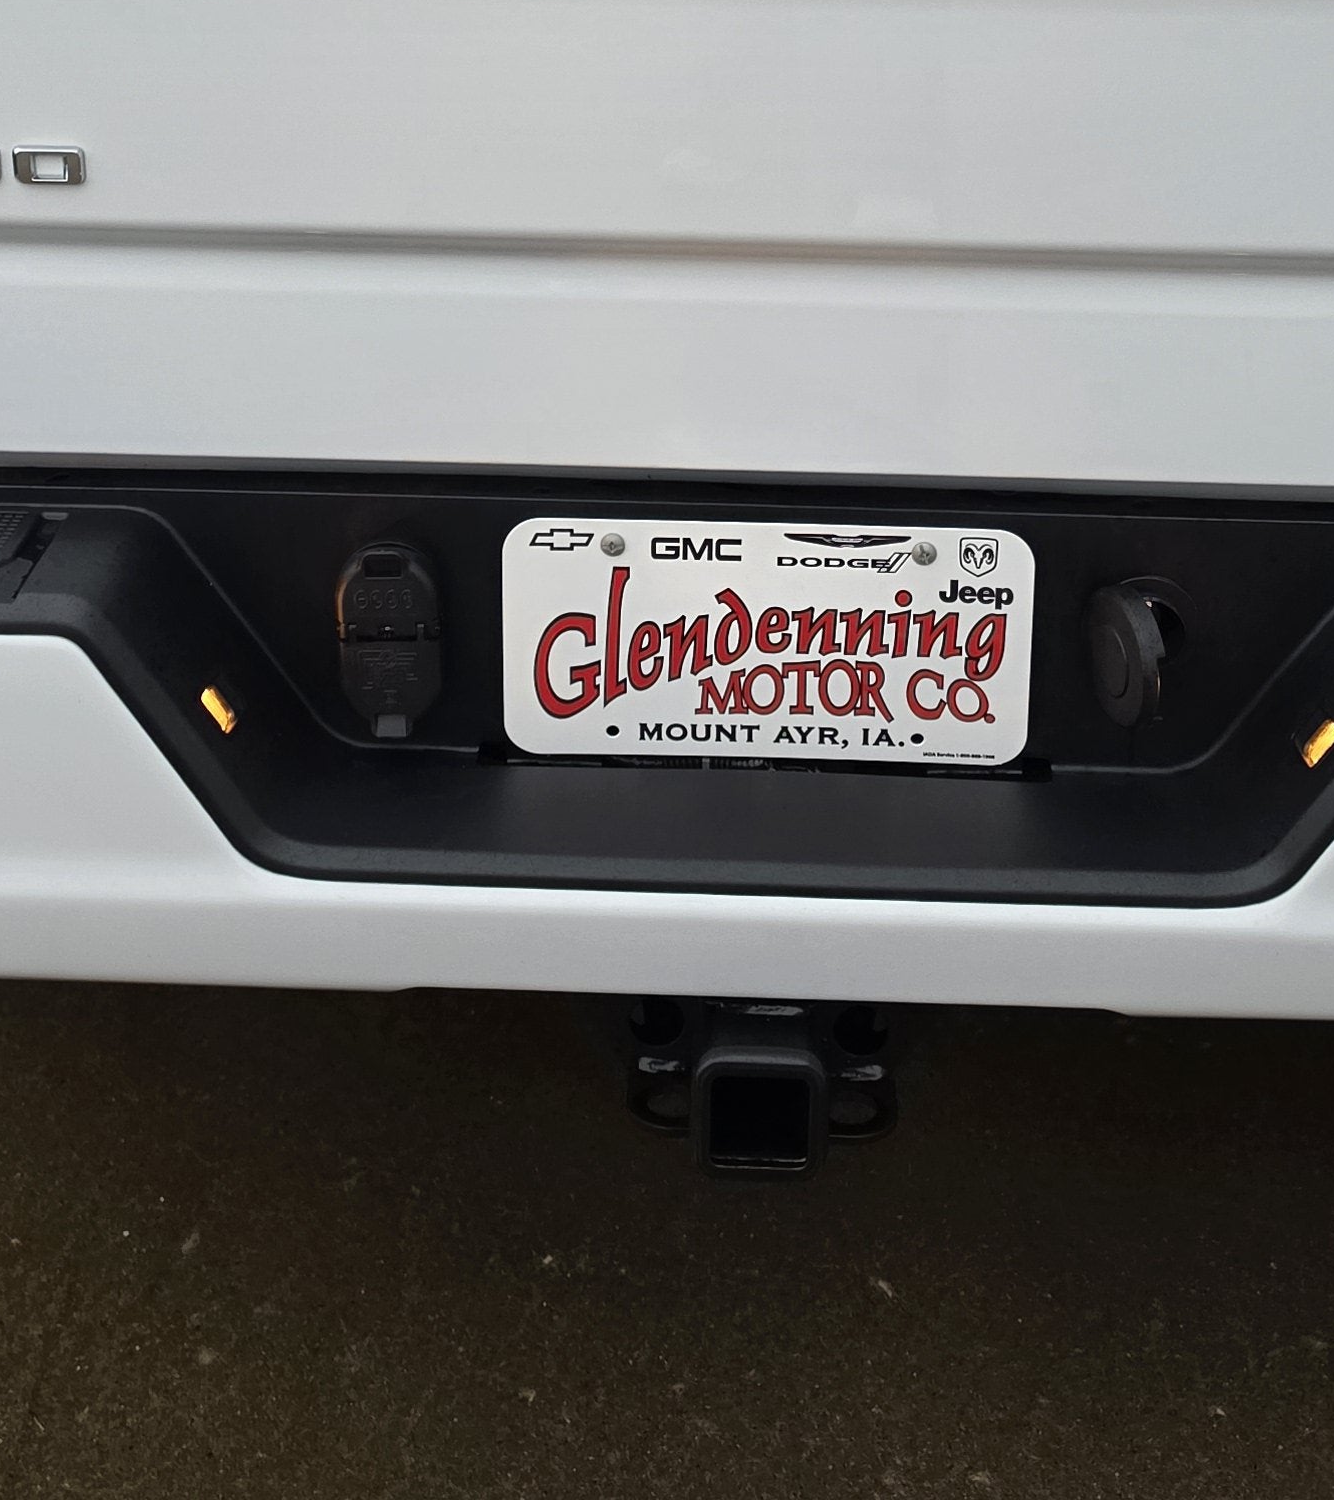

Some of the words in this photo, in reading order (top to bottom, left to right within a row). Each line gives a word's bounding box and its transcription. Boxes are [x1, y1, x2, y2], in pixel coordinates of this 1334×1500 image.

[650, 536, 743, 563] GMC
[776, 556, 890, 570] DODGE
[938, 579, 1015, 610] Jeep
[533, 565, 1008, 720] Glendenning
[694, 658, 895, 723] MOTOR
[905, 668, 997, 725] CO.
[638, 722, 761, 746] MOUNT
[772, 725, 851, 750] AYR,
